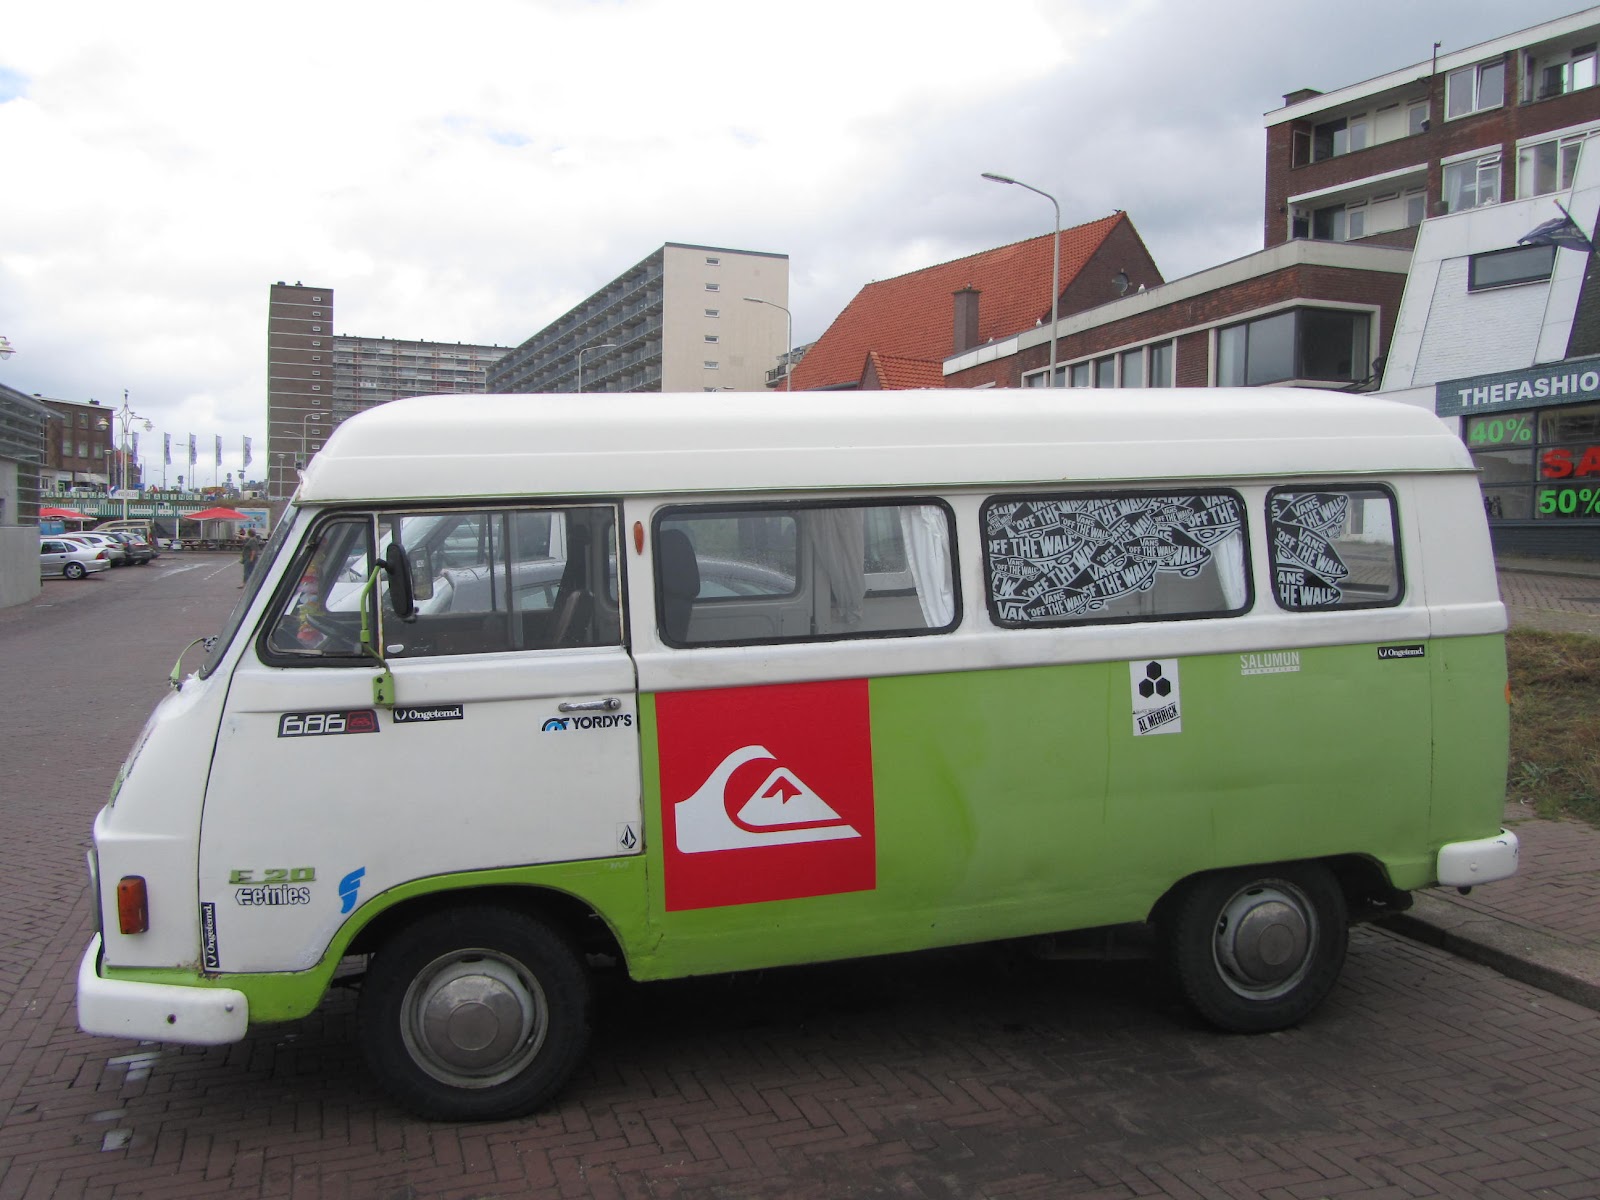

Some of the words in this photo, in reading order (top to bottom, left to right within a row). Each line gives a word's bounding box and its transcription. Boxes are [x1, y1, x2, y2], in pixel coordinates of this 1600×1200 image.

[1458, 371, 1600, 407] THEFASHIO
[1469, 416, 1532, 443] 40%
[1291, 495, 1320, 517] VANS
[1539, 488, 1600, 514] 50%
[1076, 513, 1096, 527] VANS
[1209, 501, 1237, 525] THE
[1299, 509, 1323, 528] THE
[1076, 522, 1090, 537] THE
[1010, 538, 1039, 558] THE
[1140, 538, 1160, 547] VANS
[1298, 527, 1328, 554] VANS
[1006, 557, 1025, 566] VANS
[1142, 546, 1157, 557] THE
[1297, 541, 1316, 567] THE
[1009, 564, 1021, 575] THE
[1046, 562, 1076, 588] THE
[1277, 566, 1305, 585] ANS
[1095, 573, 1125, 596] THE
[1041, 589, 1067, 605] VANS
[1279, 585, 1299, 607] HE
[1046, 601, 1067, 616] THE
[282, 713, 346, 735] 686
[408, 707, 462, 721] Ongetemd.
[572, 713, 632, 730] YORDY'S
[1138, 719, 1148, 733] AL
[1147, 704, 1178, 728] MERRICK
[264, 867, 316, 883] 20
[251, 884, 311, 906] etnies
